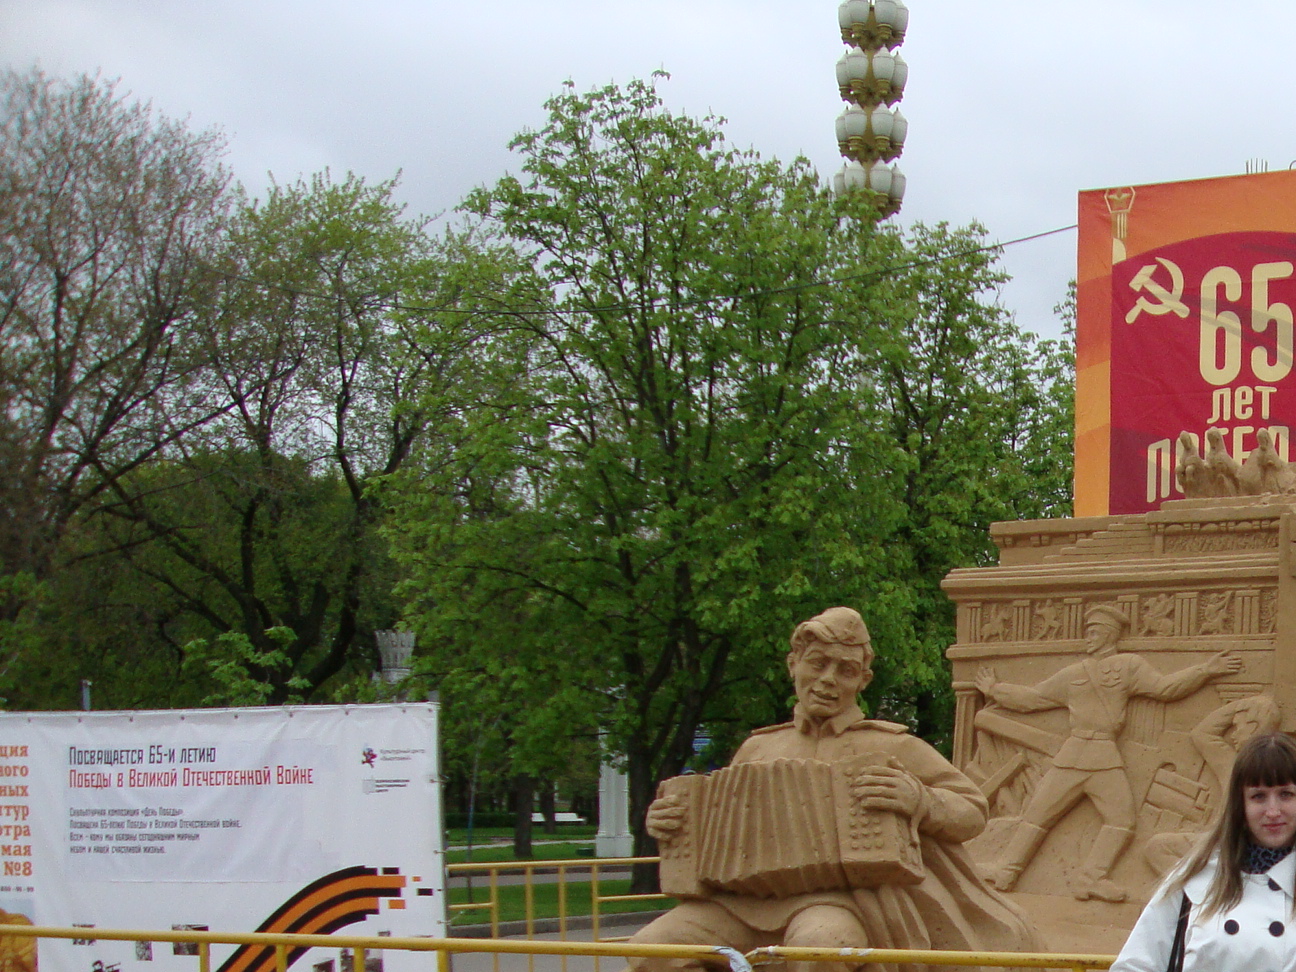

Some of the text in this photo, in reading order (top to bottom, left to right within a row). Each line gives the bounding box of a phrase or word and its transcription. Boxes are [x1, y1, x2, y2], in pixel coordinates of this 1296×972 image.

[1200, 261, 1293, 385] 65
[1207, 385, 1277, 424] лет
[0, 805, 29, 821] тур
[1, 845, 32, 857] мая
